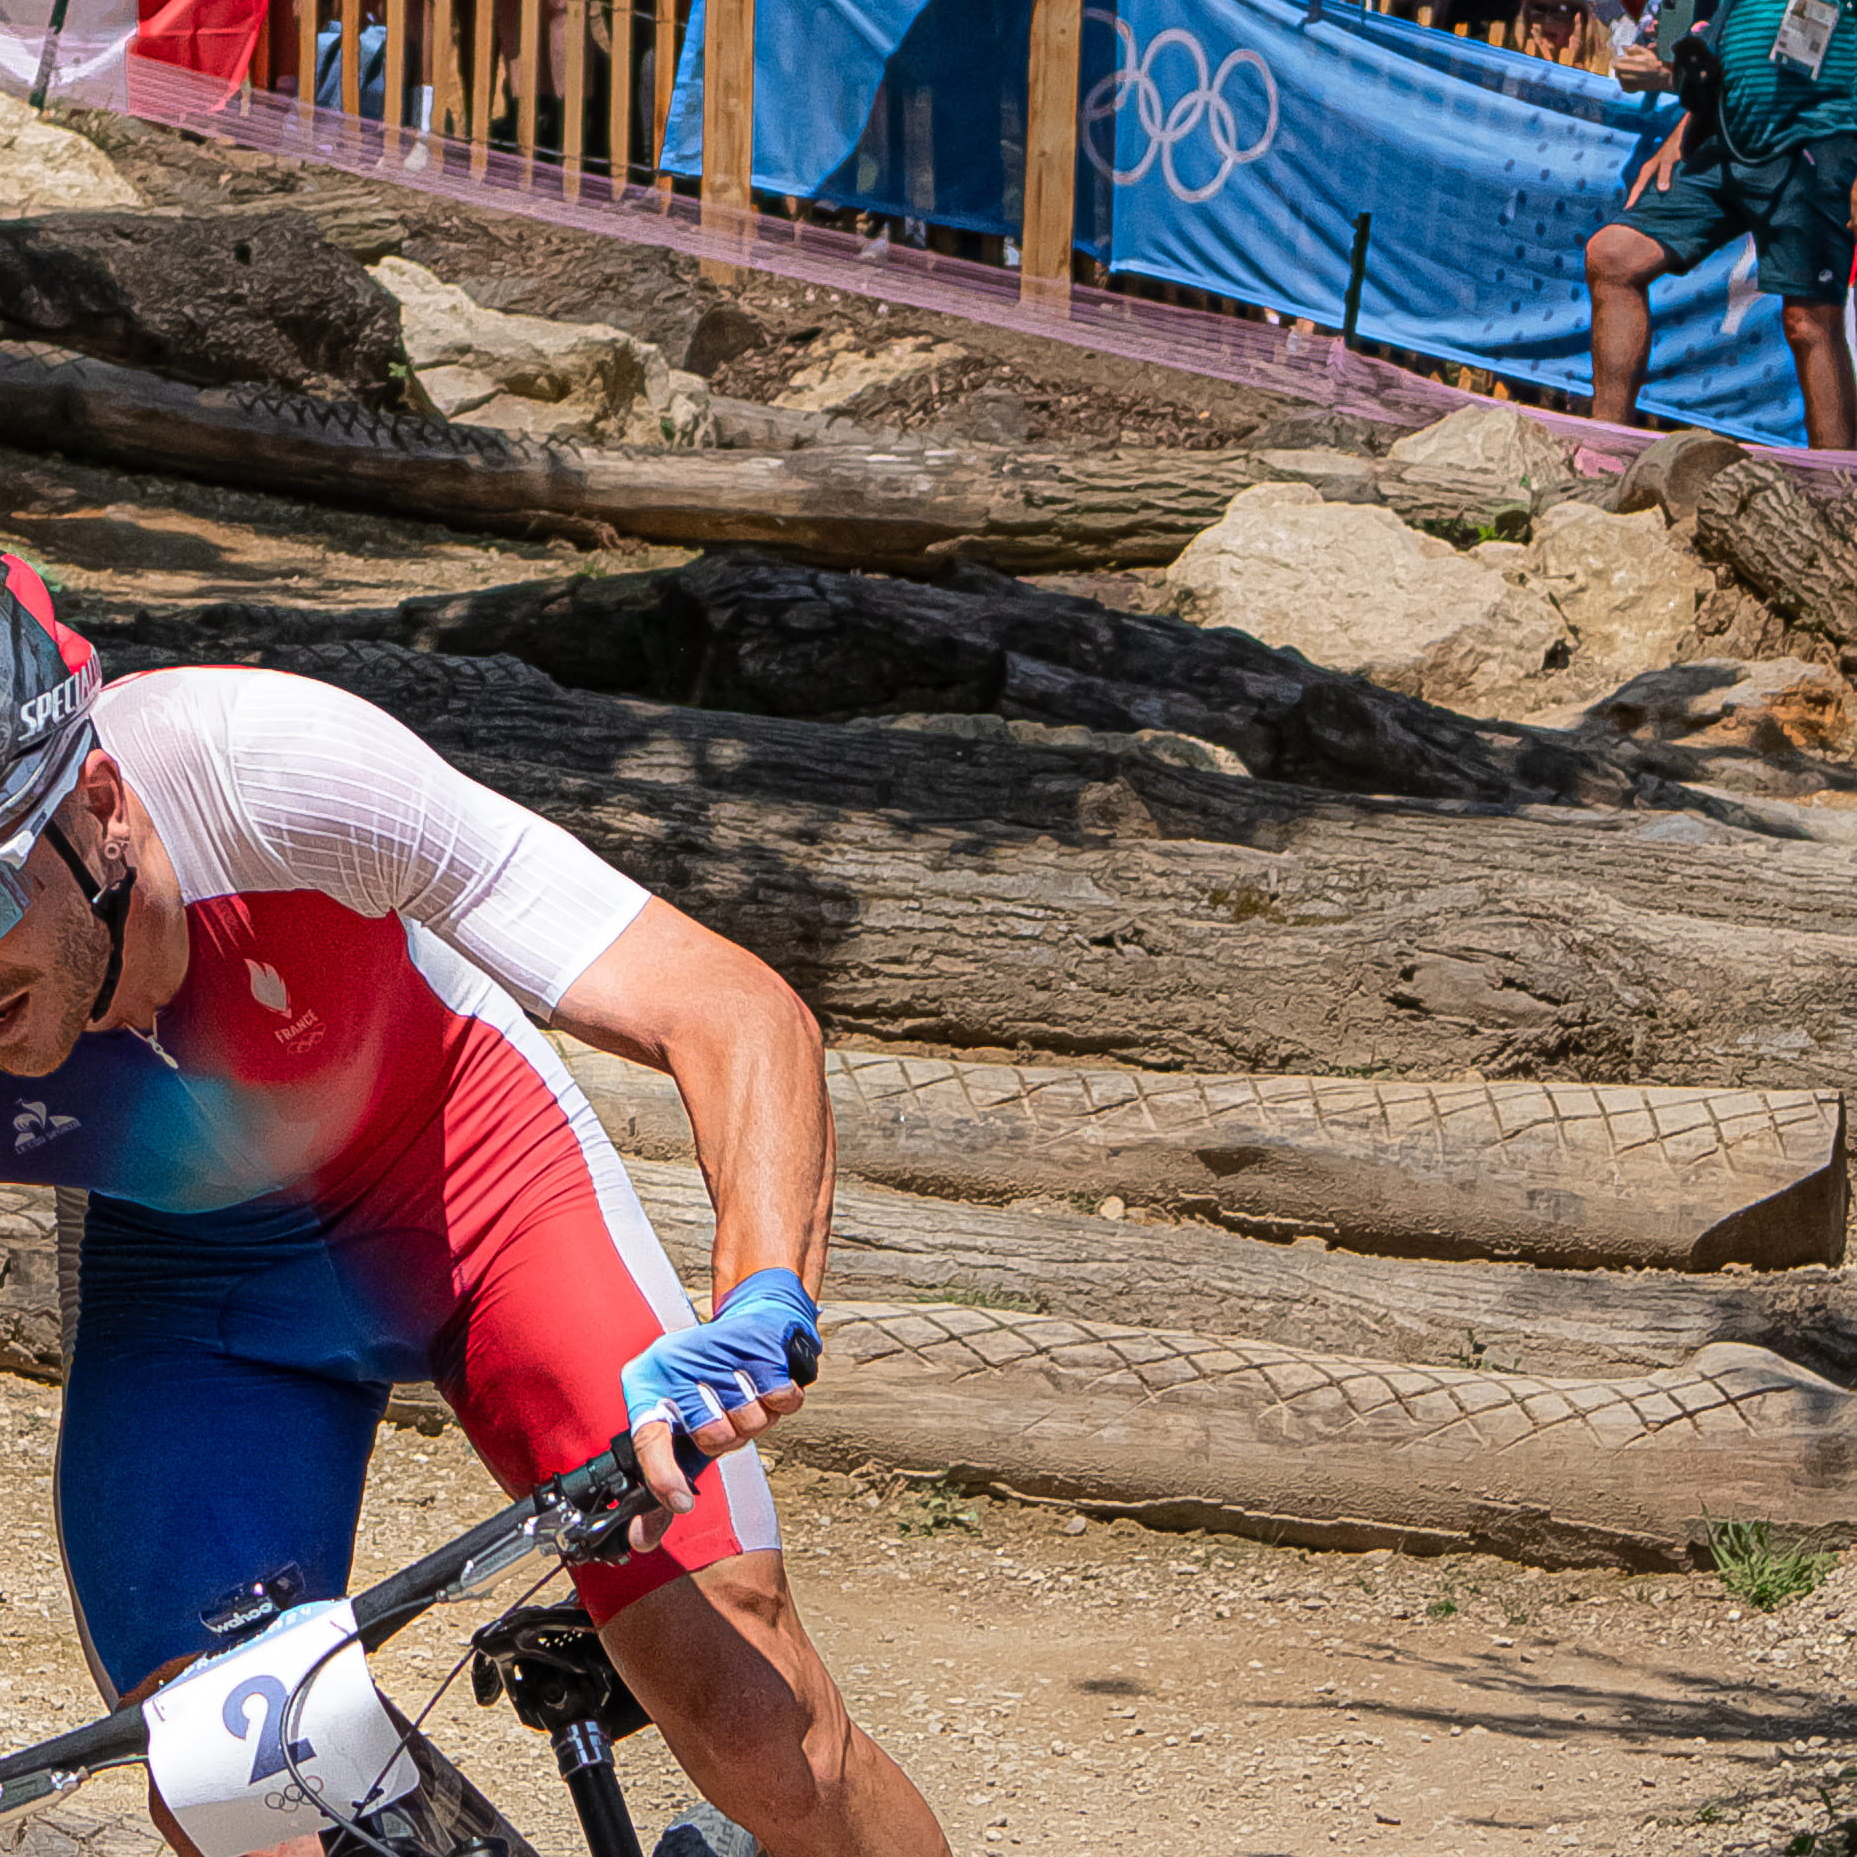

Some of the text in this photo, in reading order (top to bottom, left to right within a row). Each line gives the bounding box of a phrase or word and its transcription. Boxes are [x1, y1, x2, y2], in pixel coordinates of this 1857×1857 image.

[274, 1008, 319, 1044] FRANCE
[211, 1601, 274, 1634] wahoo
[222, 1675, 317, 1785] 2
